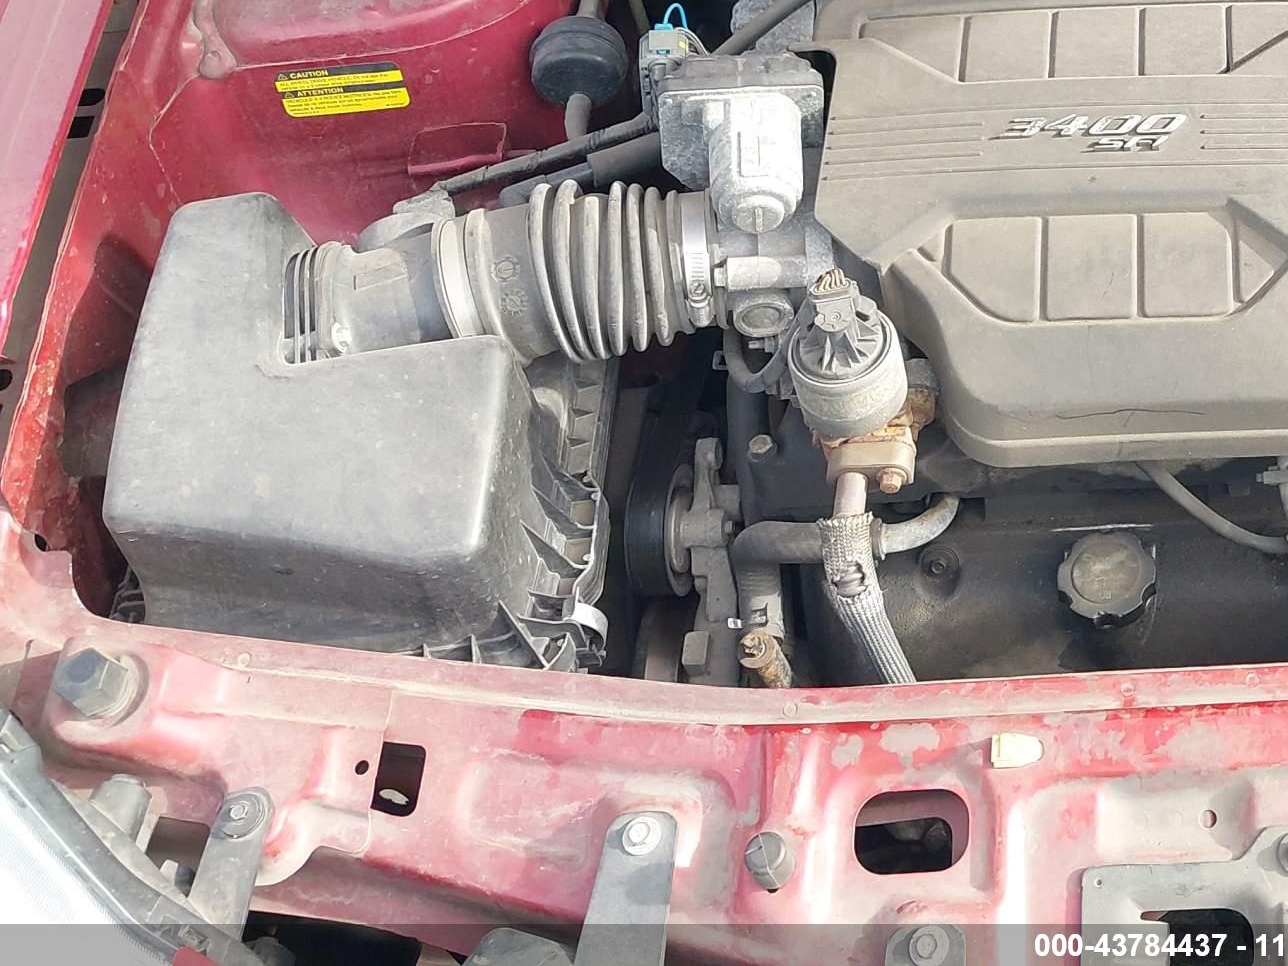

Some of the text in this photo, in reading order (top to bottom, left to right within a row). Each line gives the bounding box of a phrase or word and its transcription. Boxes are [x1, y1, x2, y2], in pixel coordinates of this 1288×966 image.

[290, 70, 329, 79] CAUTION
[297, 87, 344, 97] ATTENTION
[990, 113, 1188, 139] 3400
